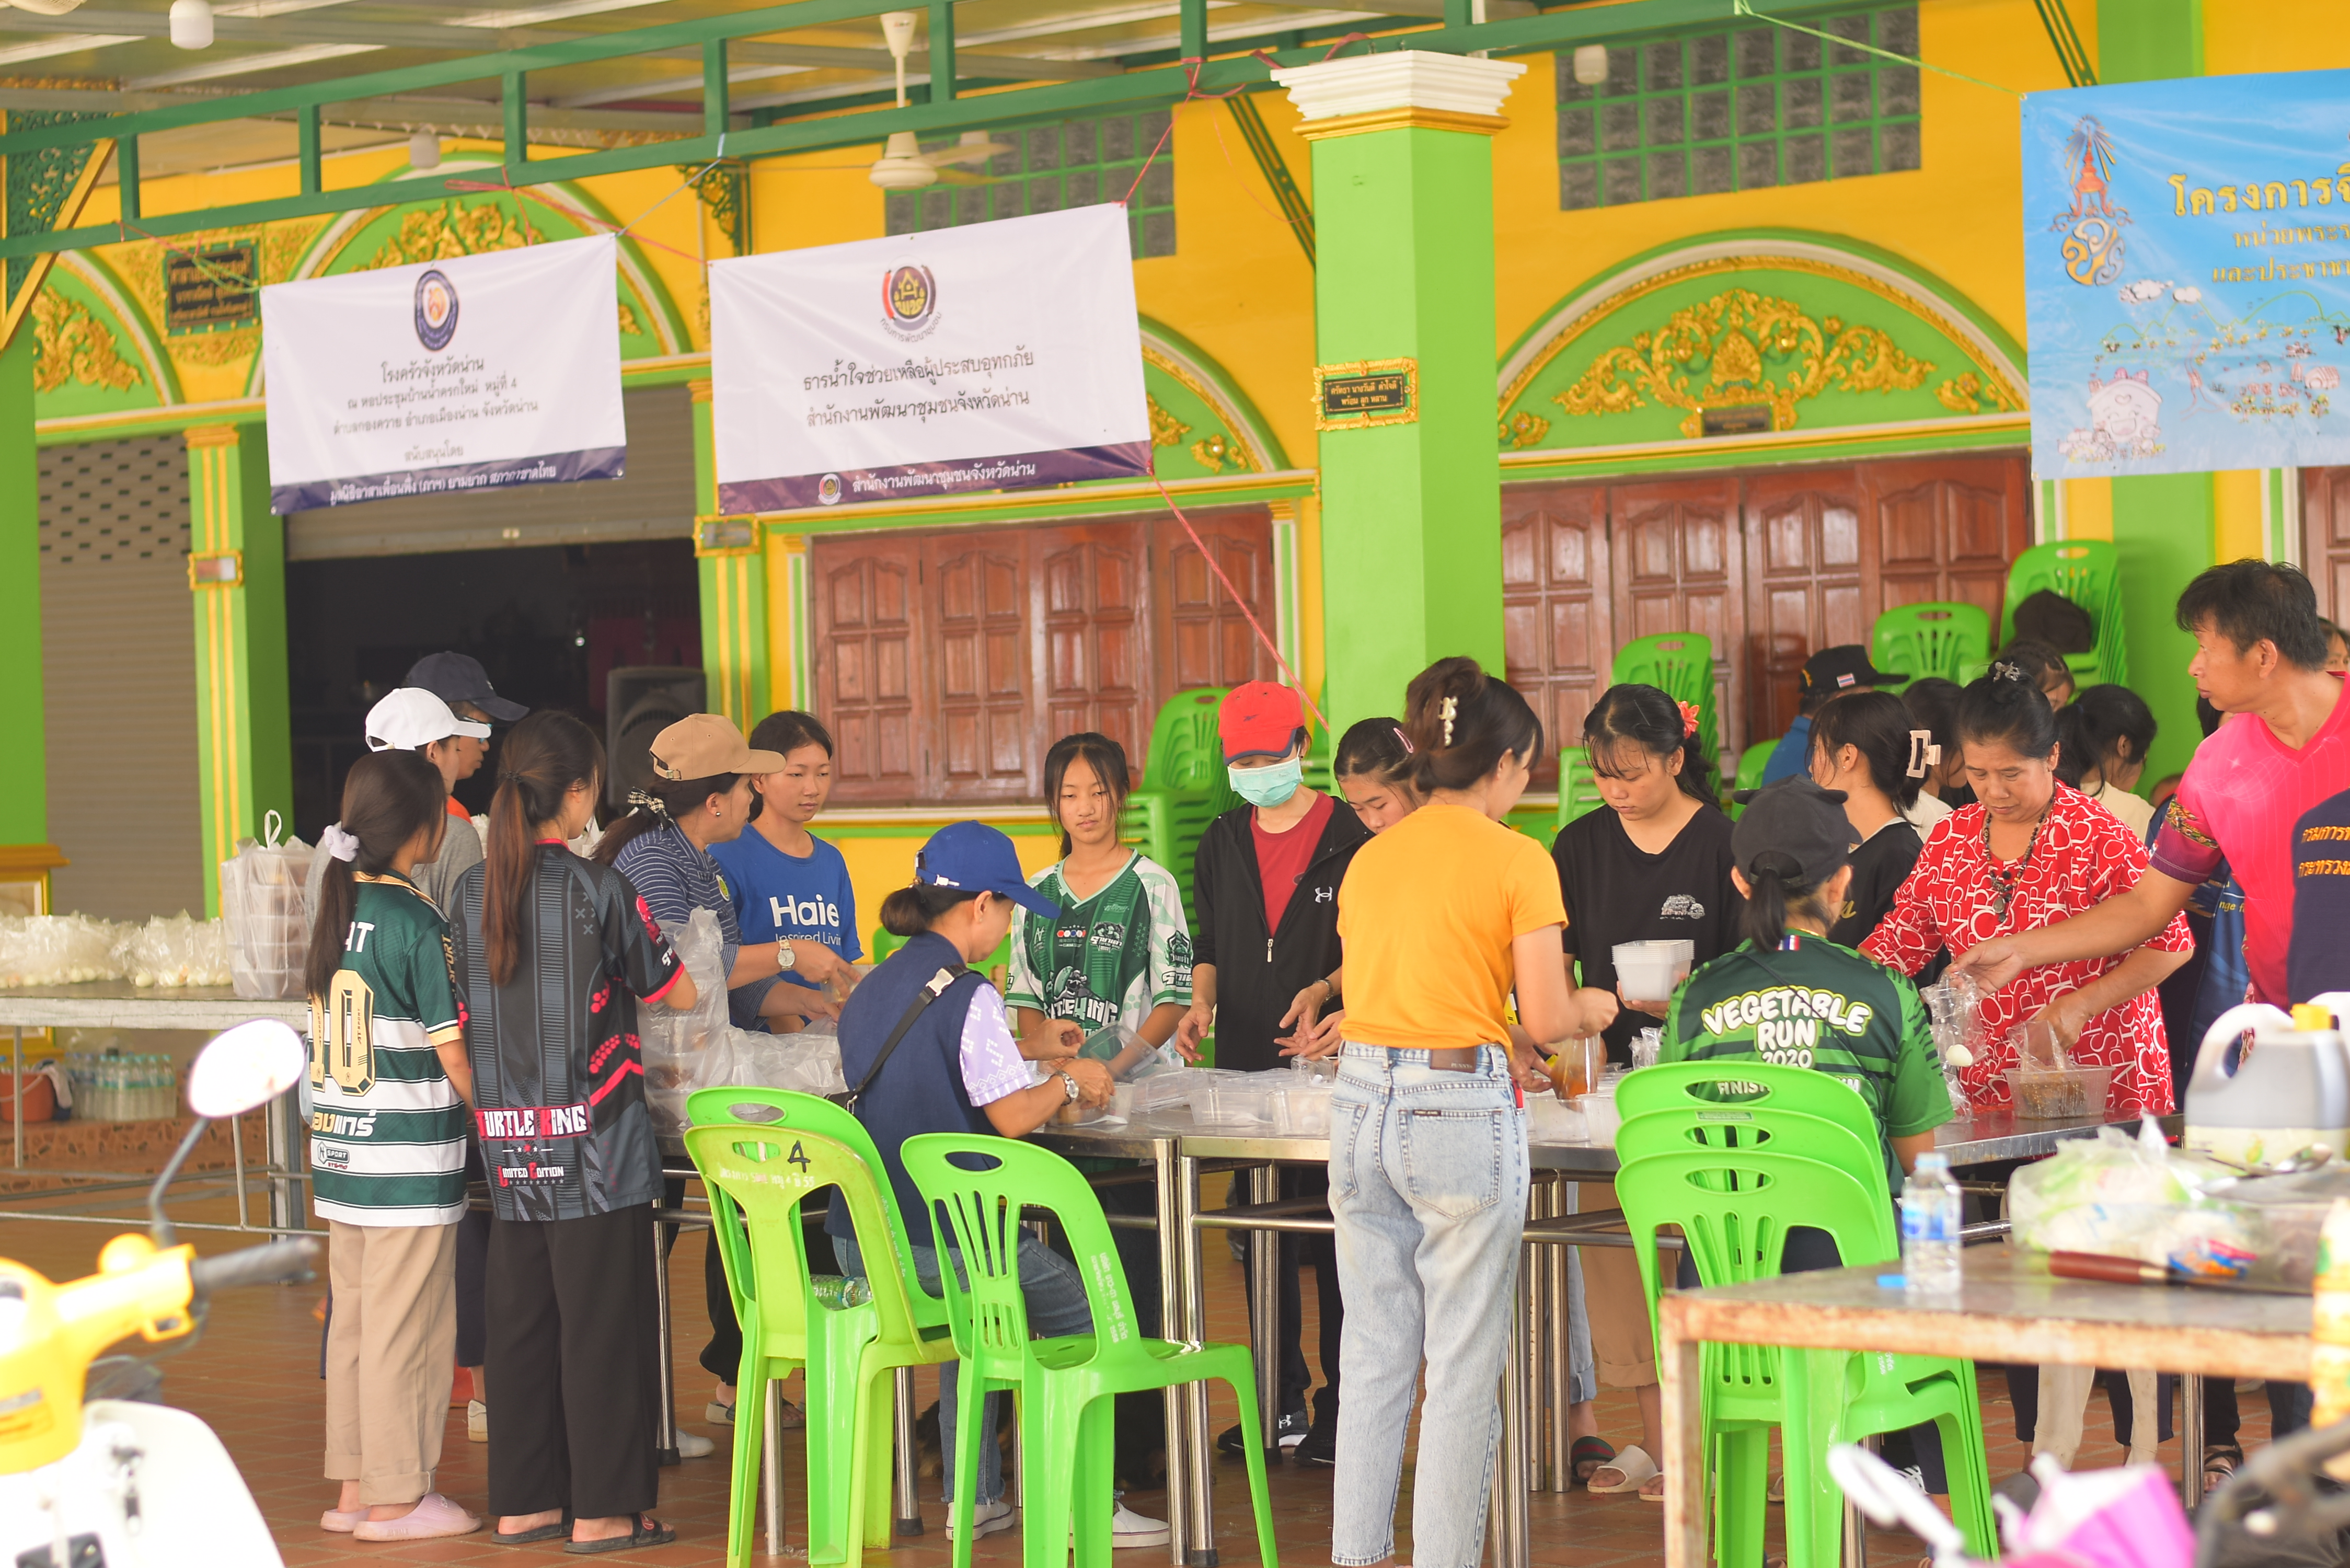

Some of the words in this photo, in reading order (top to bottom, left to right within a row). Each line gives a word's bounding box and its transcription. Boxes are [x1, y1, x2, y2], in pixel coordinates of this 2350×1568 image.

[381, 355, 484, 384] โรงครัวจังหวัดน่าน
[803, 344, 1034, 390] ธารน้ำใจช่วยเหลือผู้ประสบอุทกภัย
[486, 371, 506, 397] หมู่ที่
[511, 378, 517, 388] 4
[406, 406, 478, 427] อำเภอเมืองน่าน
[482, 398, 538, 416] จังหวัดน่าน
[807, 386, 1030, 426] สำนักงานพัฒนาชุมชนจังหวัดน่าน
[853, 460, 1035, 492] สำนักงานพัฒนาชุมชนจังหวัดน่าน
[1703, 989, 1870, 1035] VEGETABLE
[1757, 1018, 1817, 1051] RUN
[1762, 1050, 1813, 1068] 2020
[476, 1110, 535, 1137] TURTLE
[540, 1105, 587, 1136] KING
[327, 1150, 347, 1158] SPORT
[787, 1140, 811, 1173] 4
